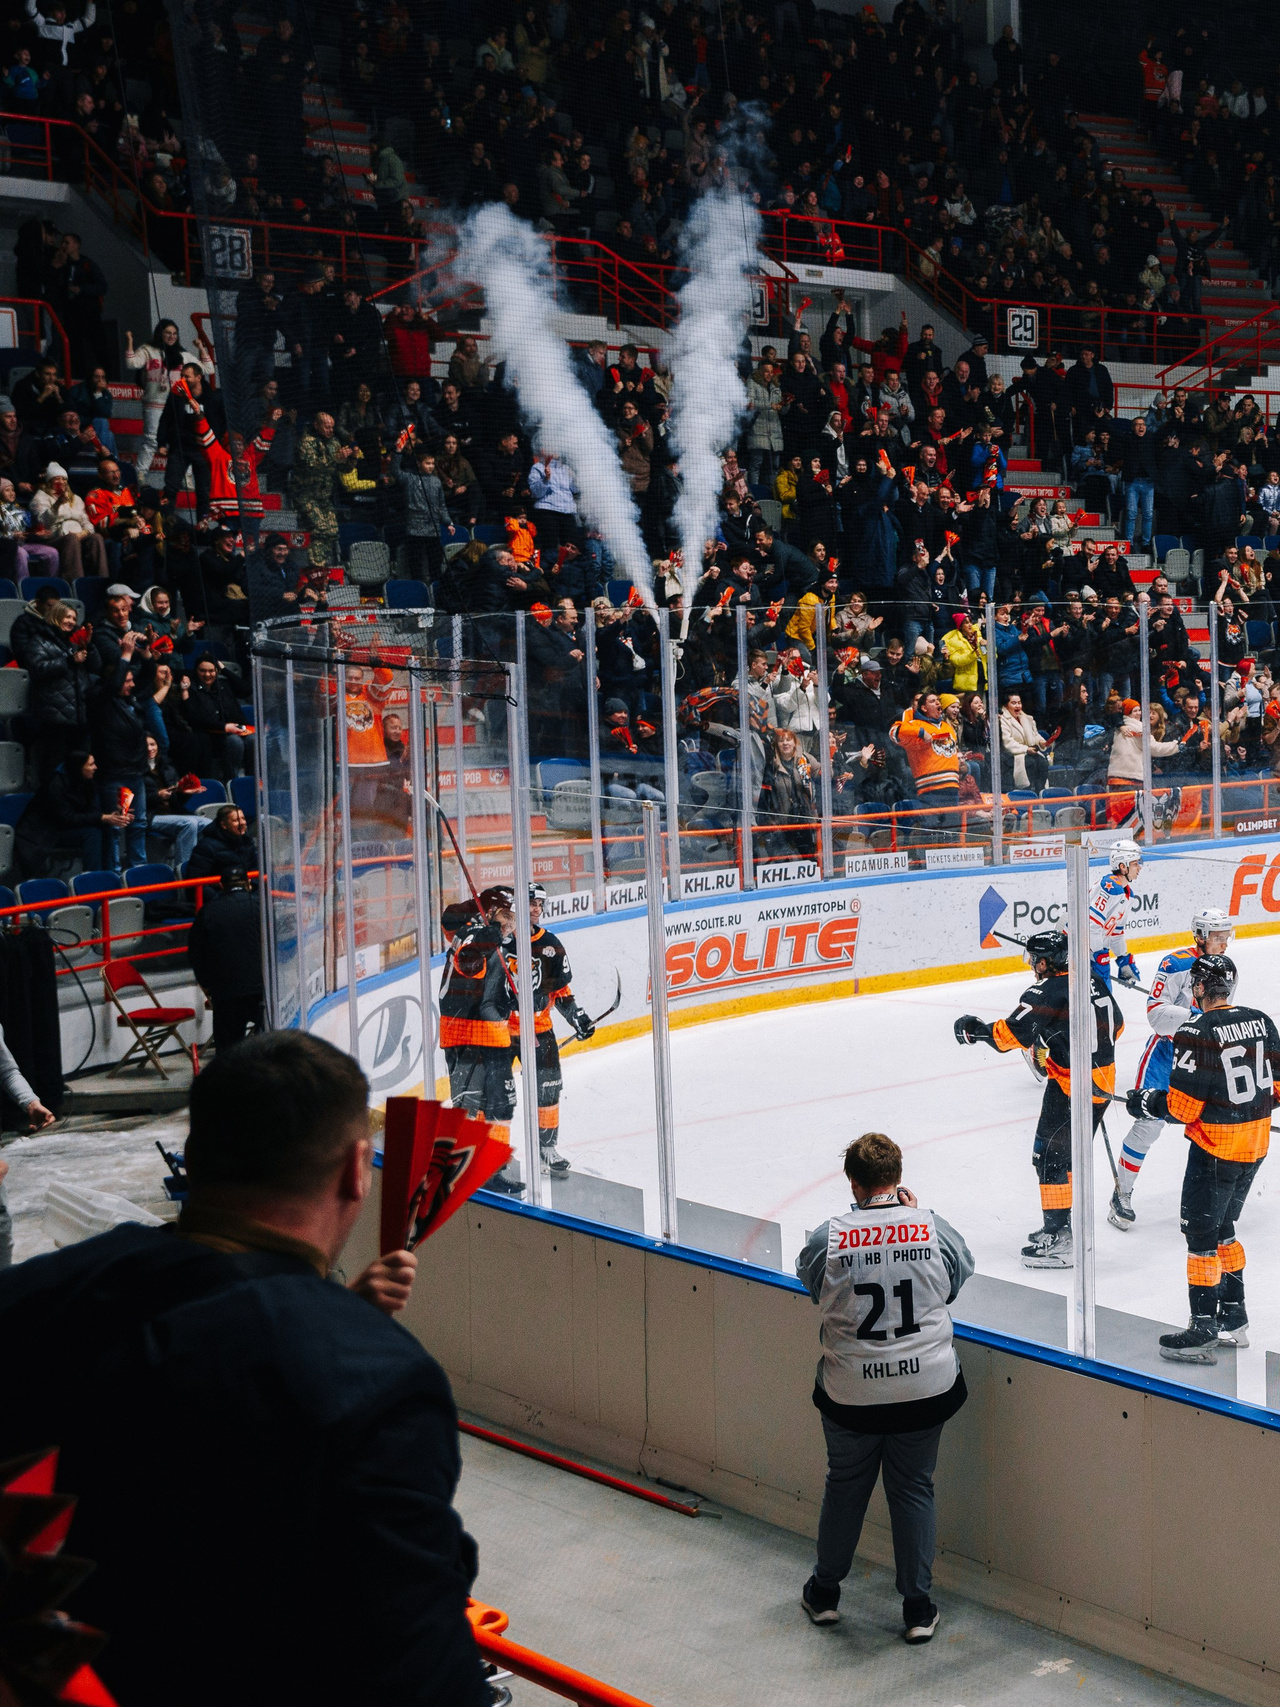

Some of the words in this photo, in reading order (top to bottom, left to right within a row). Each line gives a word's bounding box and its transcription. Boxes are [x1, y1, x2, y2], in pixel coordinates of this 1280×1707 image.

[1012, 315, 1034, 341] 29
[1038, 488, 1054, 497] ТИГРОВ
[1237, 819, 1278, 833] OLIMPBET
[927, 852, 983, 864] TICKETS.HCAMUR.RU
[1013, 846, 1063, 858] SOLITE
[762, 863, 817, 883] KHL.RU
[847, 856, 907, 873] HCAMUR.RU
[685, 873, 735, 893] KHL.RU
[758, 901, 846, 922] АККУМУЛЯТОРЫ
[665, 914, 742, 937] WWW.SOLITE.RU
[666, 917, 860, 988] SOLITE
[1214, 1018, 1268, 1047] MINAYEV
[1221, 1041, 1274, 1104] 64
[838, 1224, 930, 1249] 2022/2023
[839, 1255, 853, 1268] TV
[865, 1251, 881, 1265] HB
[893, 1247, 931, 1262] PHOTO
[854, 1279, 921, 1341] 21
[862, 1357, 920, 1379] KHL.RU
